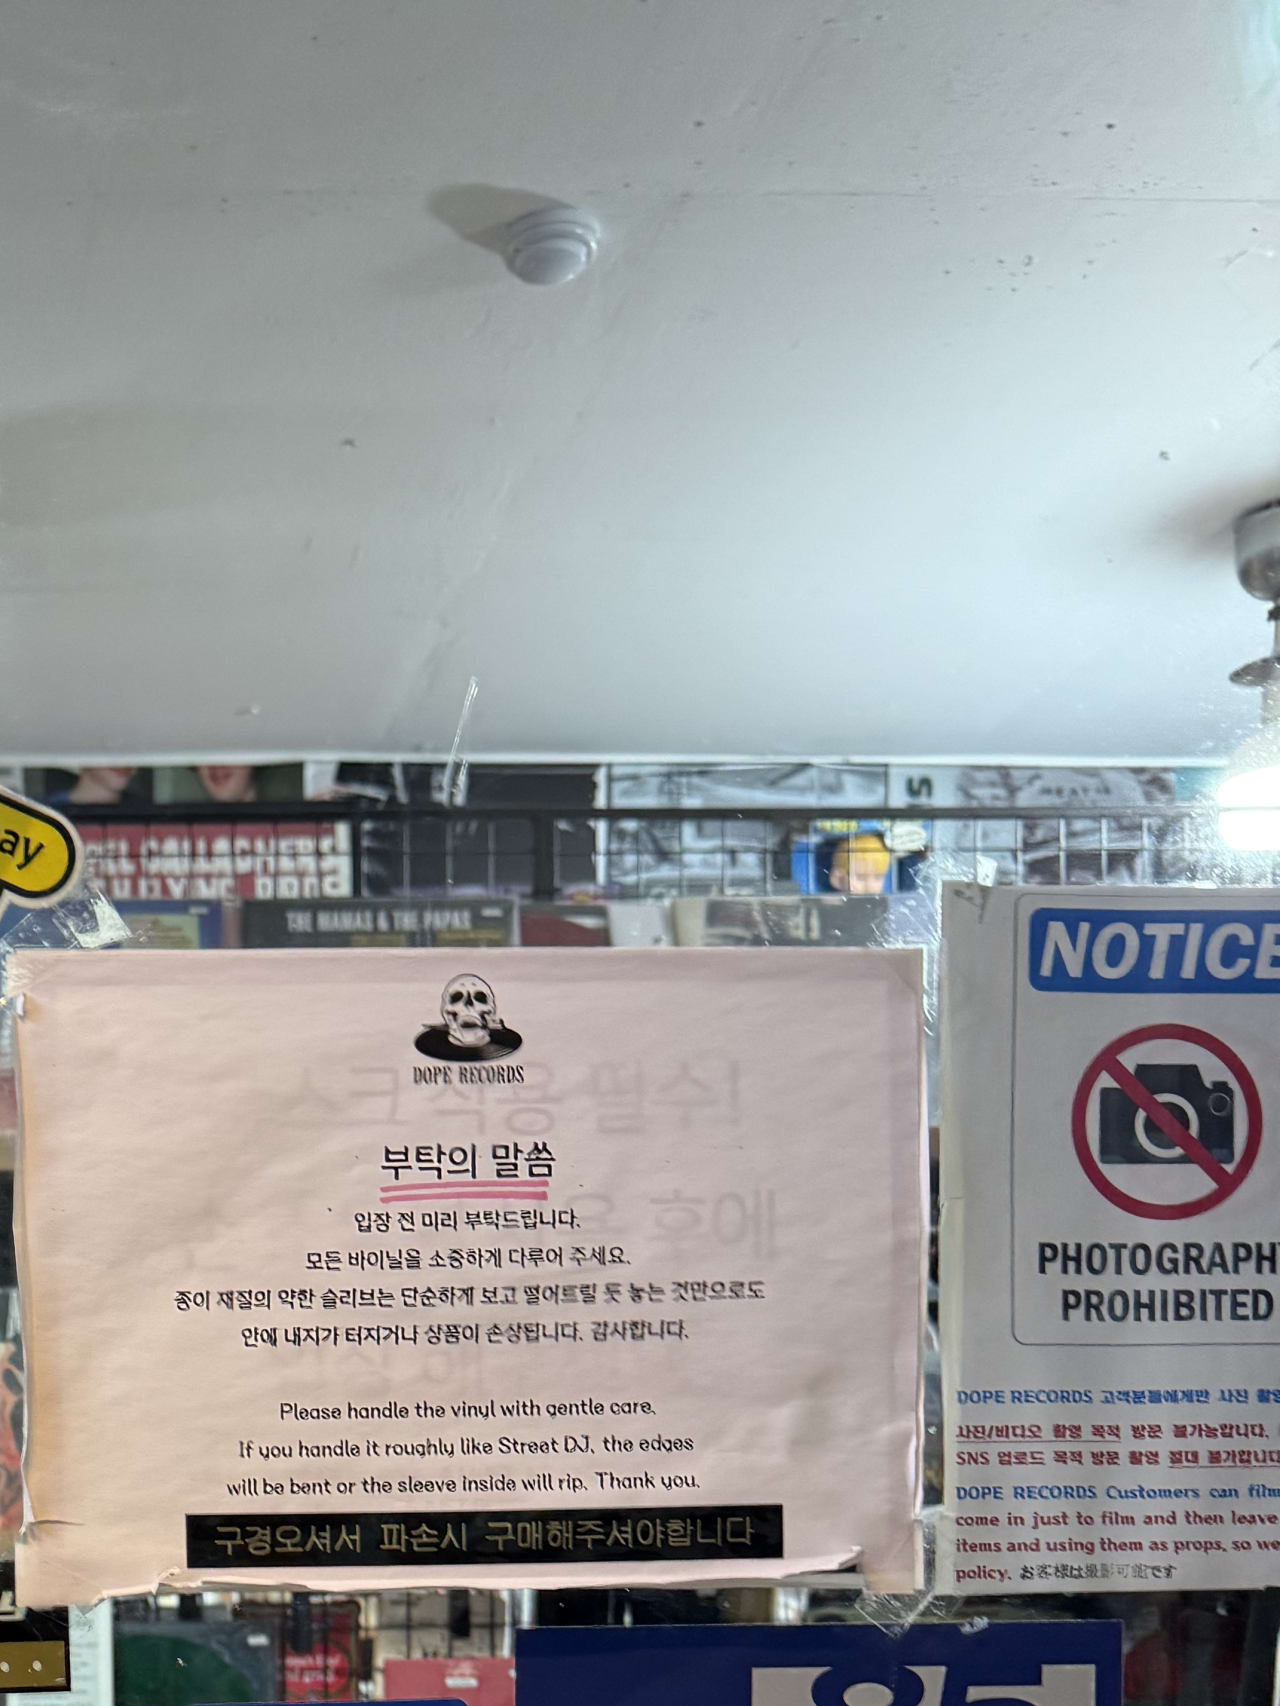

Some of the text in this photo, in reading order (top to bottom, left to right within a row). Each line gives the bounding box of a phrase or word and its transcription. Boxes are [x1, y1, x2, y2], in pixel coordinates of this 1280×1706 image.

[412, 1064, 526, 1086] DOPE RECORDS
[380, 1143, 557, 1182] 부탁의 말씀
[354, 1209, 581, 1233] 입장 미리 부탁드립니다.
[306, 1246, 632, 1271] 모든 바이닐을 소중하게 다루어 주세요.
[1038, 1242, 1280, 1275] PHOTOGRAPH
[174, 1285, 516, 1311] 종이 재질의 약한 슬리브는 단순하게 보고
[1062, 1289, 1274, 1322] PROHIBITED
[241, 1322, 584, 1348] 안에 내지가 터지거나 상품이 손상됩니다.
[280, 1398, 605, 1421] Please handle the vinyl with gentle
[956, 1389, 1094, 1405] DOPE RECORDS
[258, 1434, 695, 1461] you handle roughly like Street the edges
[956, 1450, 990, 1465] SNS
[289, 1471, 656, 1495] bent the sleeve inside Thank
[956, 1485, 1202, 1500] DOPE RECORDS Customers
[214, 1516, 755, 1556] 구경오셔서 파손시 구매해주셔야합니다
